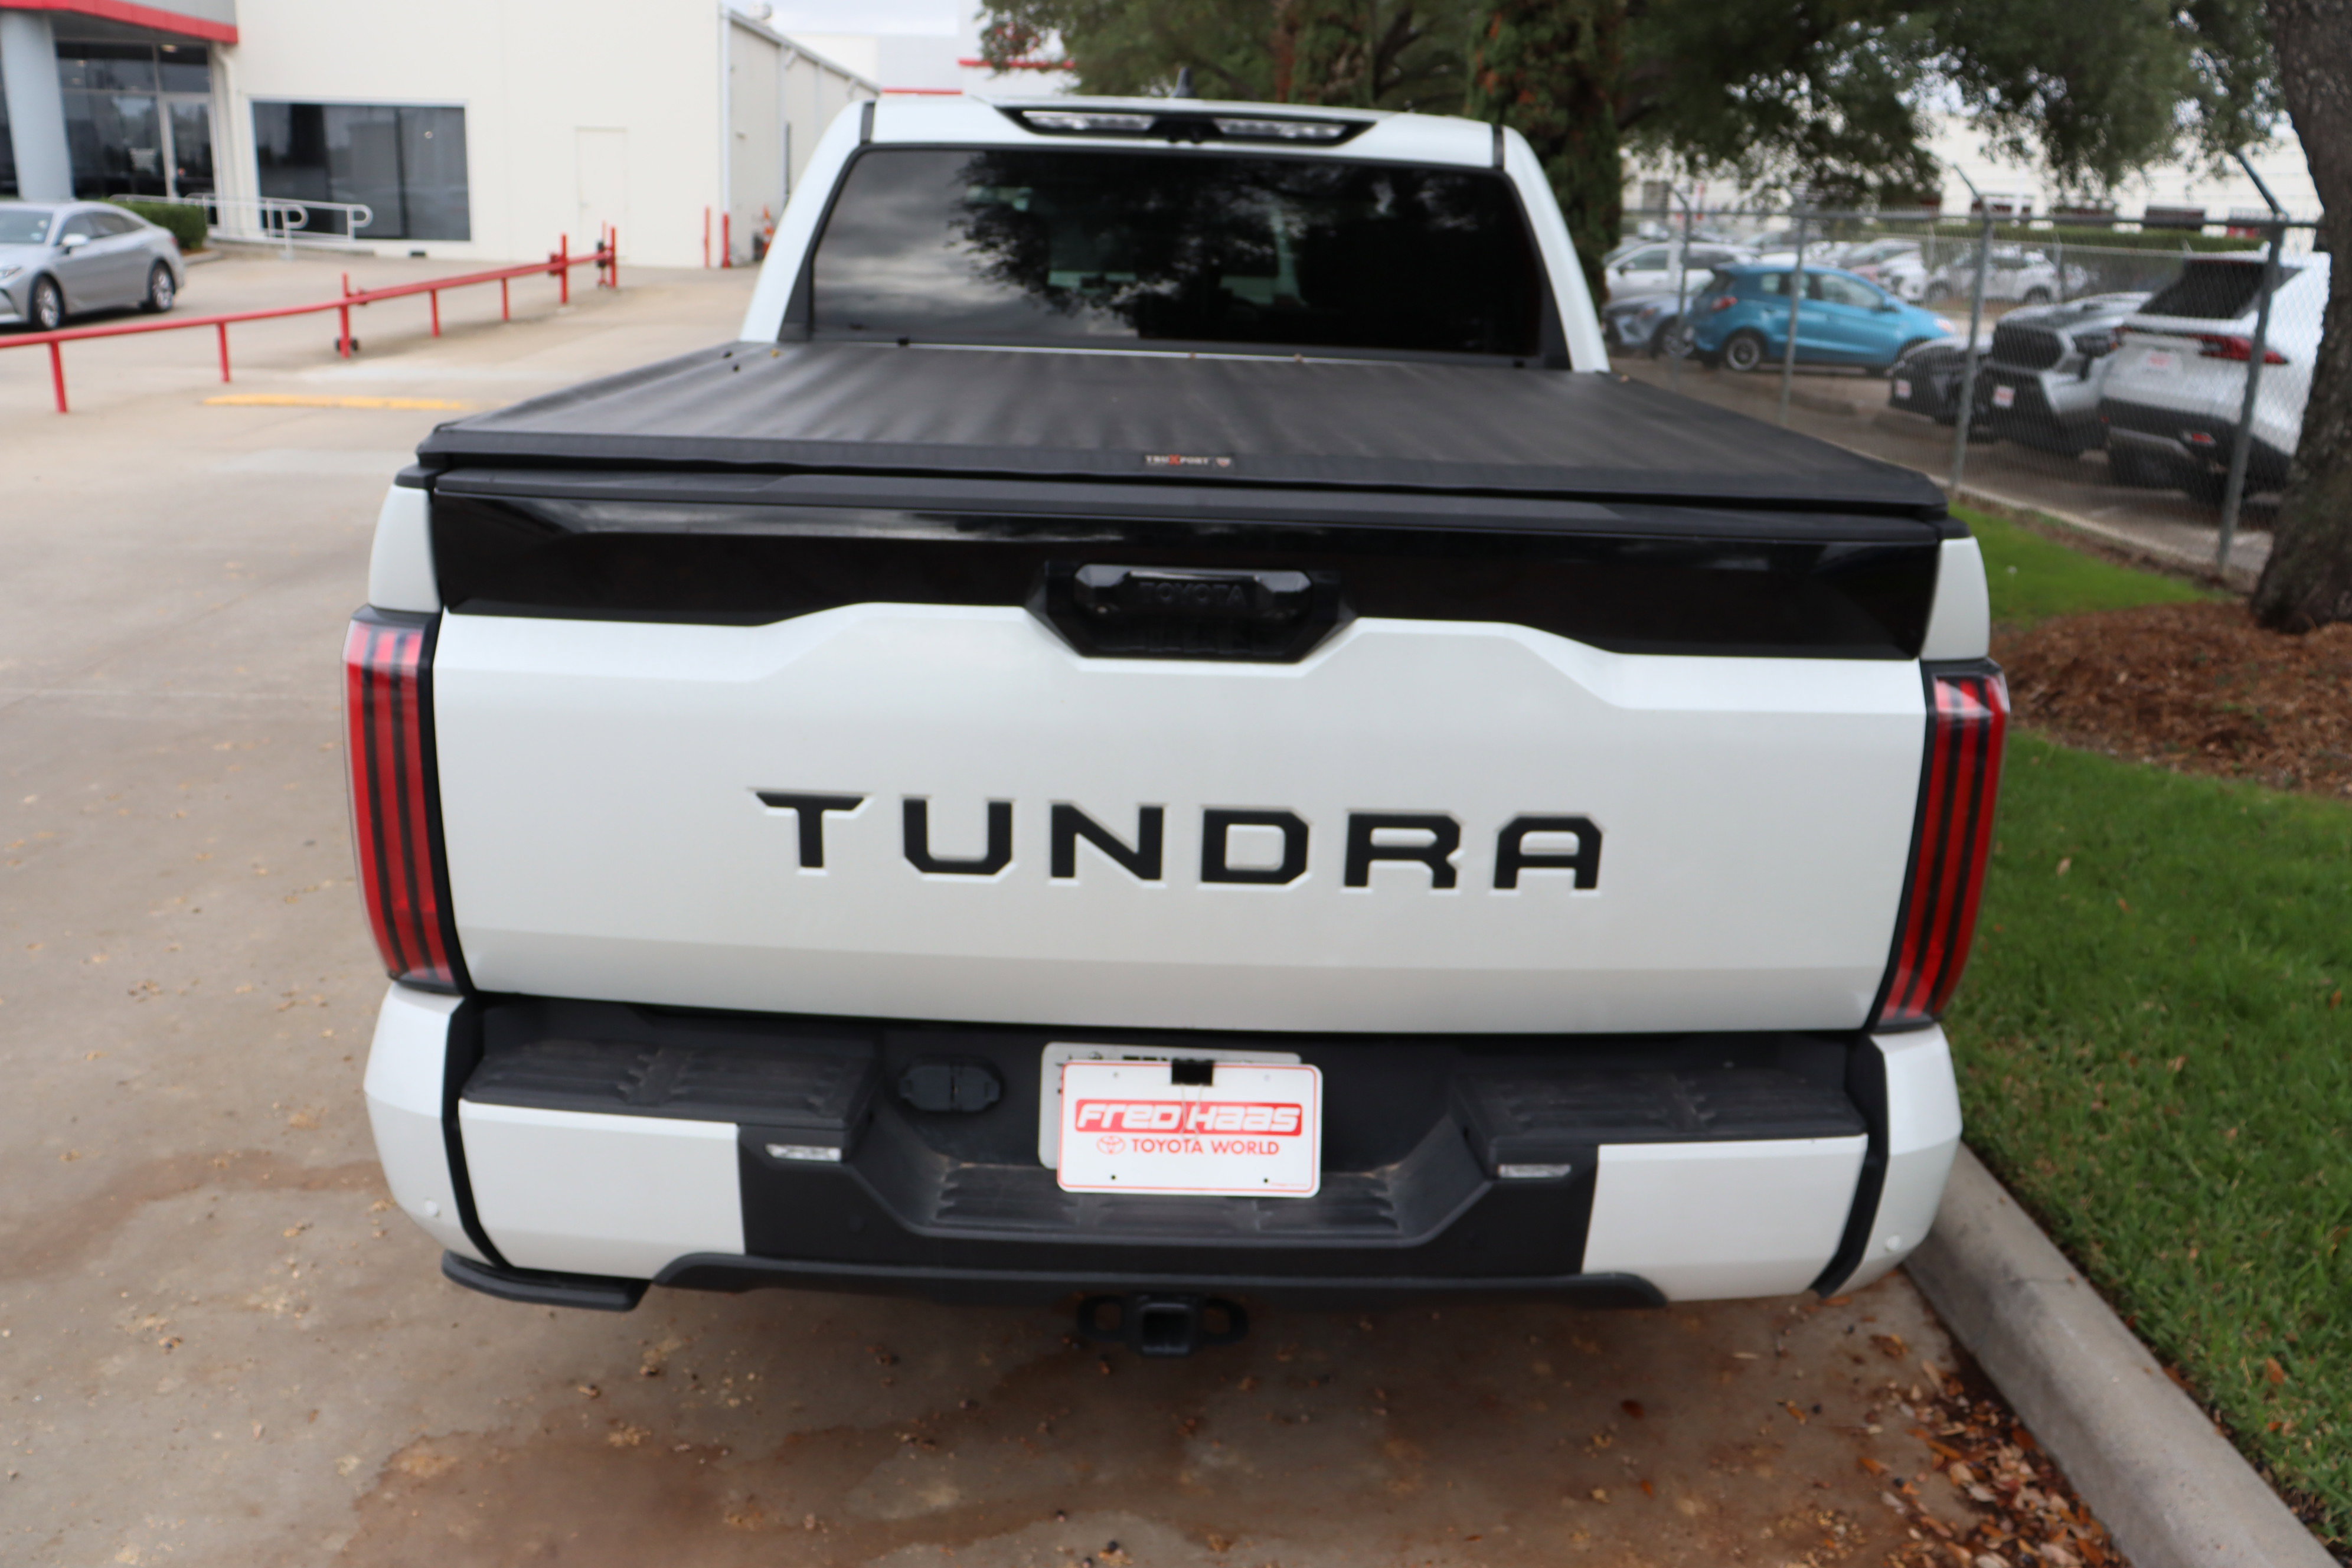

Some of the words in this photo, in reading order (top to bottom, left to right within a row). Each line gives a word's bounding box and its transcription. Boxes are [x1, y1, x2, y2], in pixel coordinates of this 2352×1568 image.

[751, 790, 1603, 891] TUNDRA
[1131, 1138, 1204, 1155] TOYOTA
[1210, 1140, 1280, 1155] WORLD
